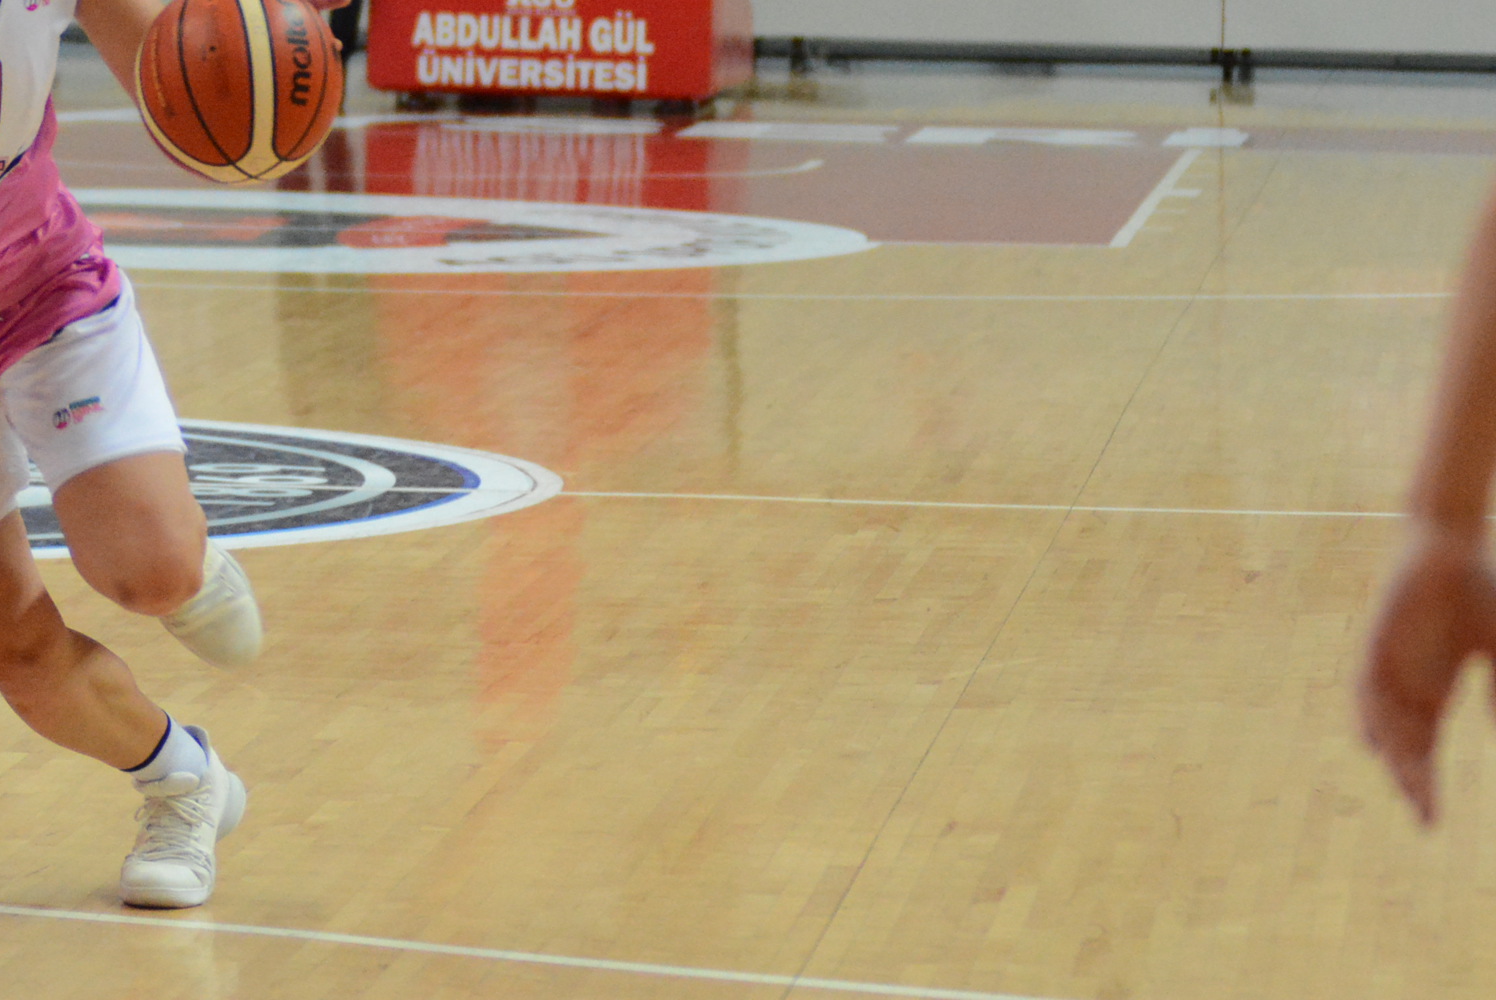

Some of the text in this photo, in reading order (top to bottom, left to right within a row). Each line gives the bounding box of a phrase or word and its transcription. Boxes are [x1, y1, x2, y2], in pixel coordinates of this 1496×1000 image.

[412, 10, 655, 54] ABDULLAH GÜL
[417, 49, 648, 92] ÜNİVERSİTESİ
